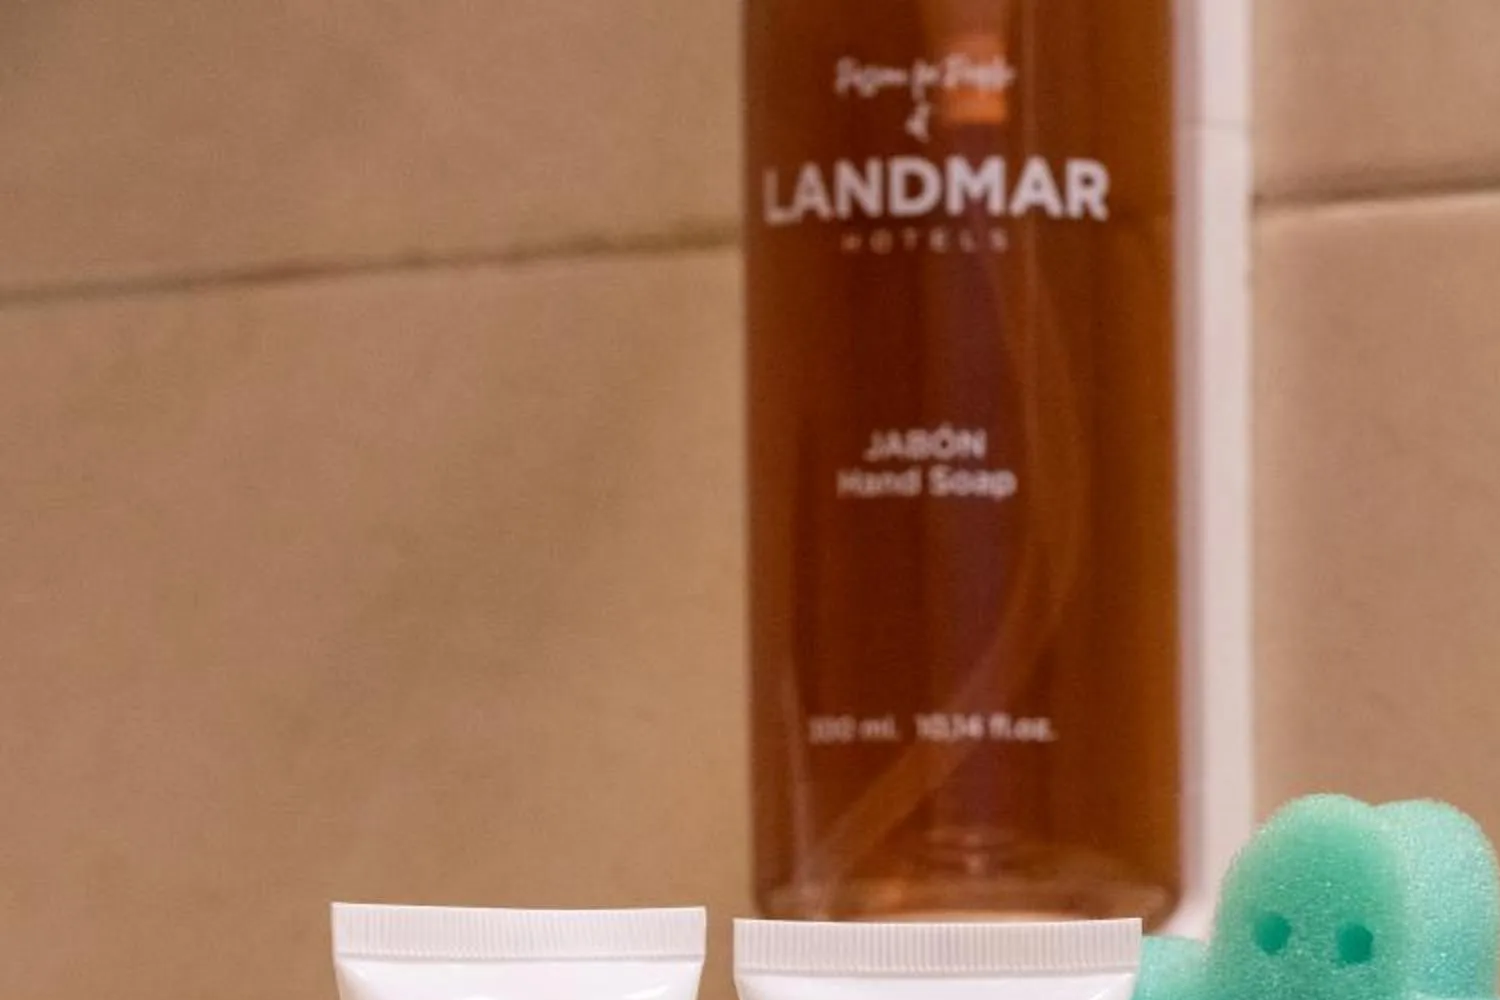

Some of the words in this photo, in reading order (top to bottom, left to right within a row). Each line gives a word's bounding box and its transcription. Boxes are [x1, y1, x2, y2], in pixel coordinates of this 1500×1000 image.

[763, 154, 1111, 227] LANDMAR
[863, 423, 988, 461] JABÓN
[836, 466, 922, 497] Hand
[928, 464, 1018, 500] Soap
